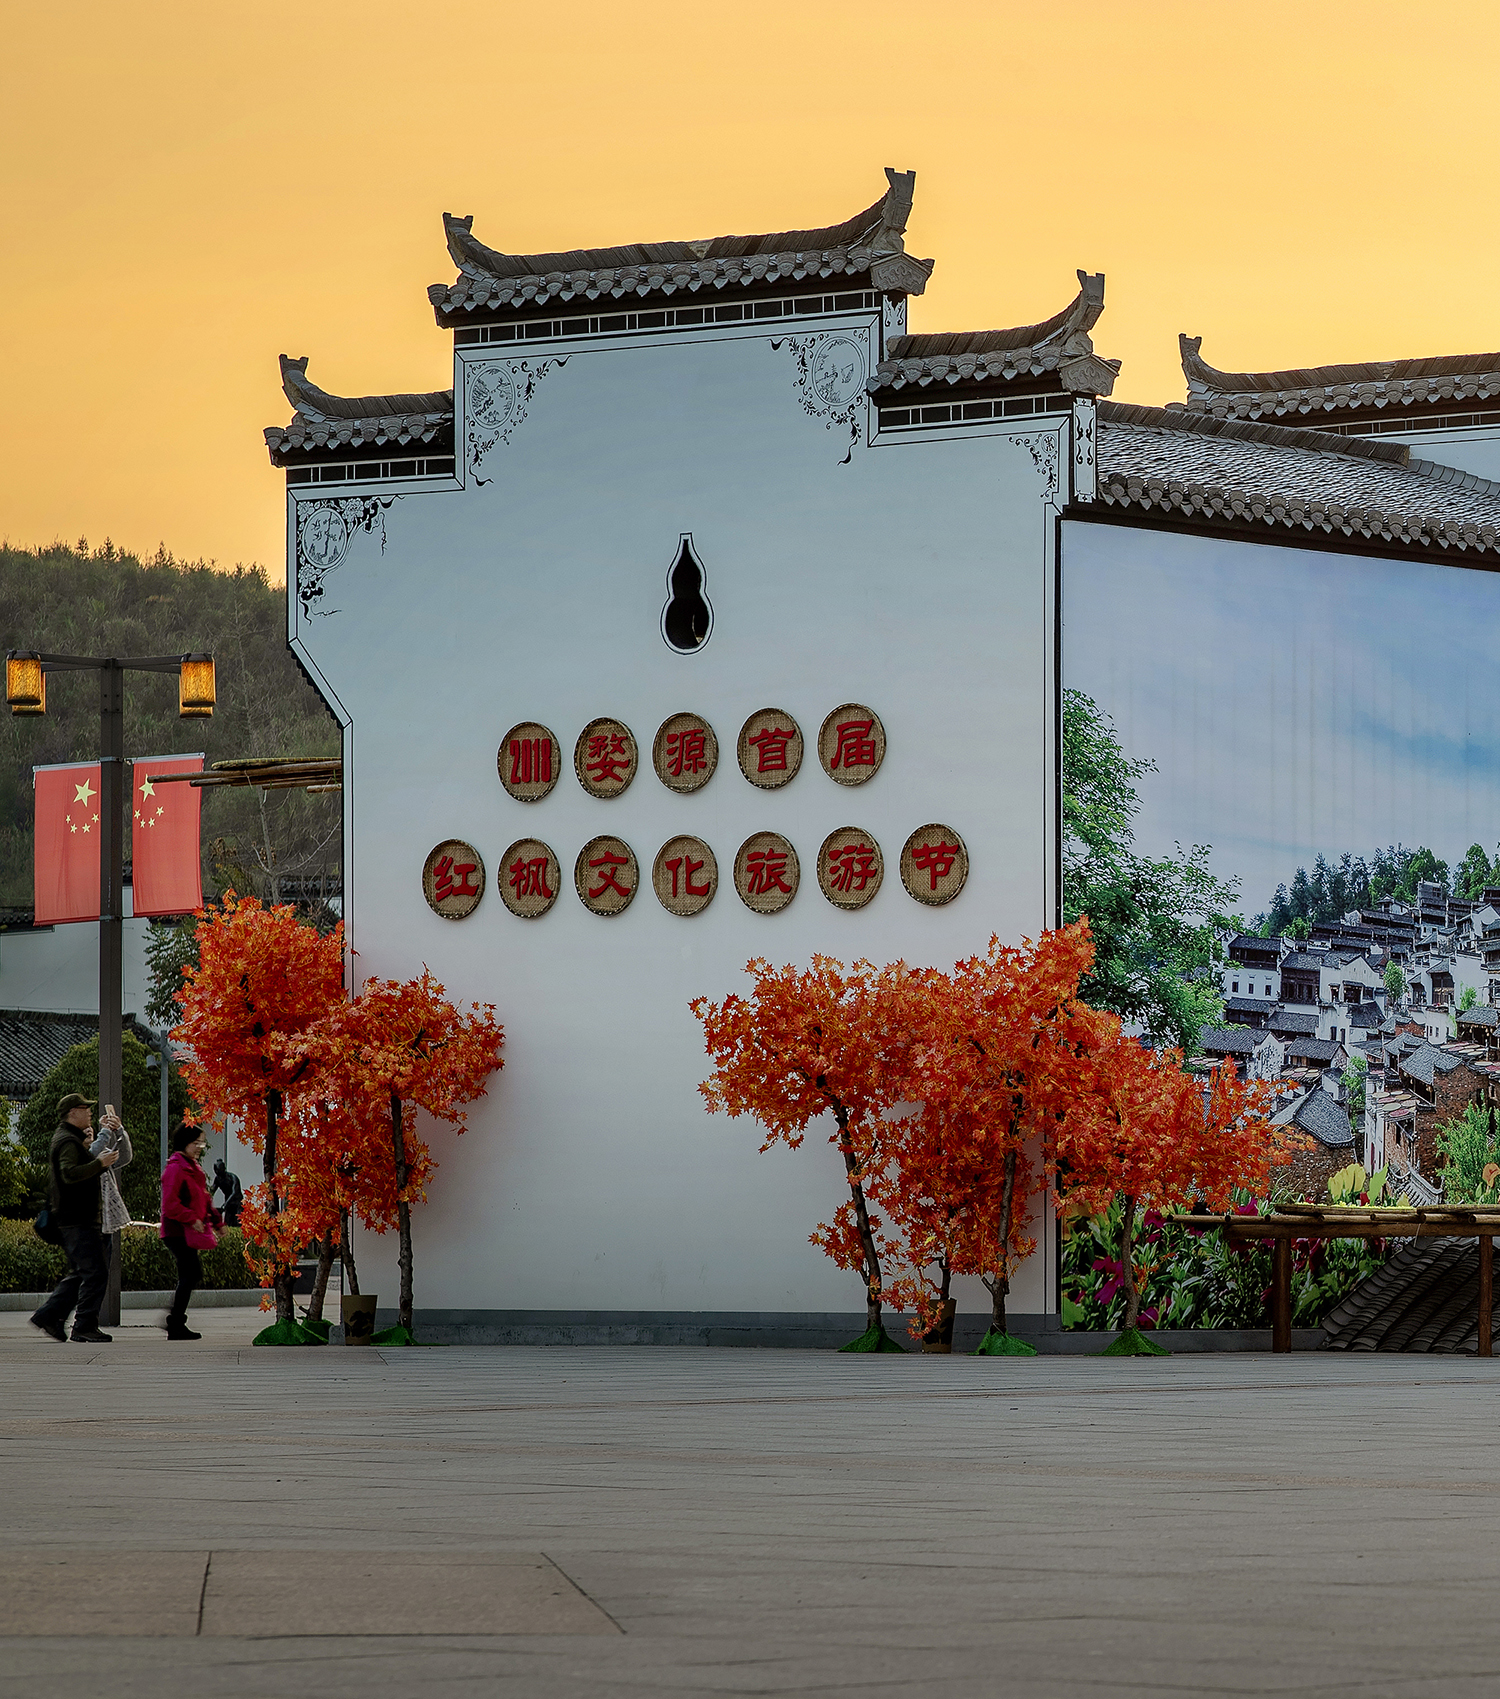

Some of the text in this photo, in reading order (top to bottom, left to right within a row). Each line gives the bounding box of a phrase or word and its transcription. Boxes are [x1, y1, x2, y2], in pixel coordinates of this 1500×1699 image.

[509, 719, 876, 784] 2018婺源首届
[432, 840, 960, 902] 红枫文化旅游节
